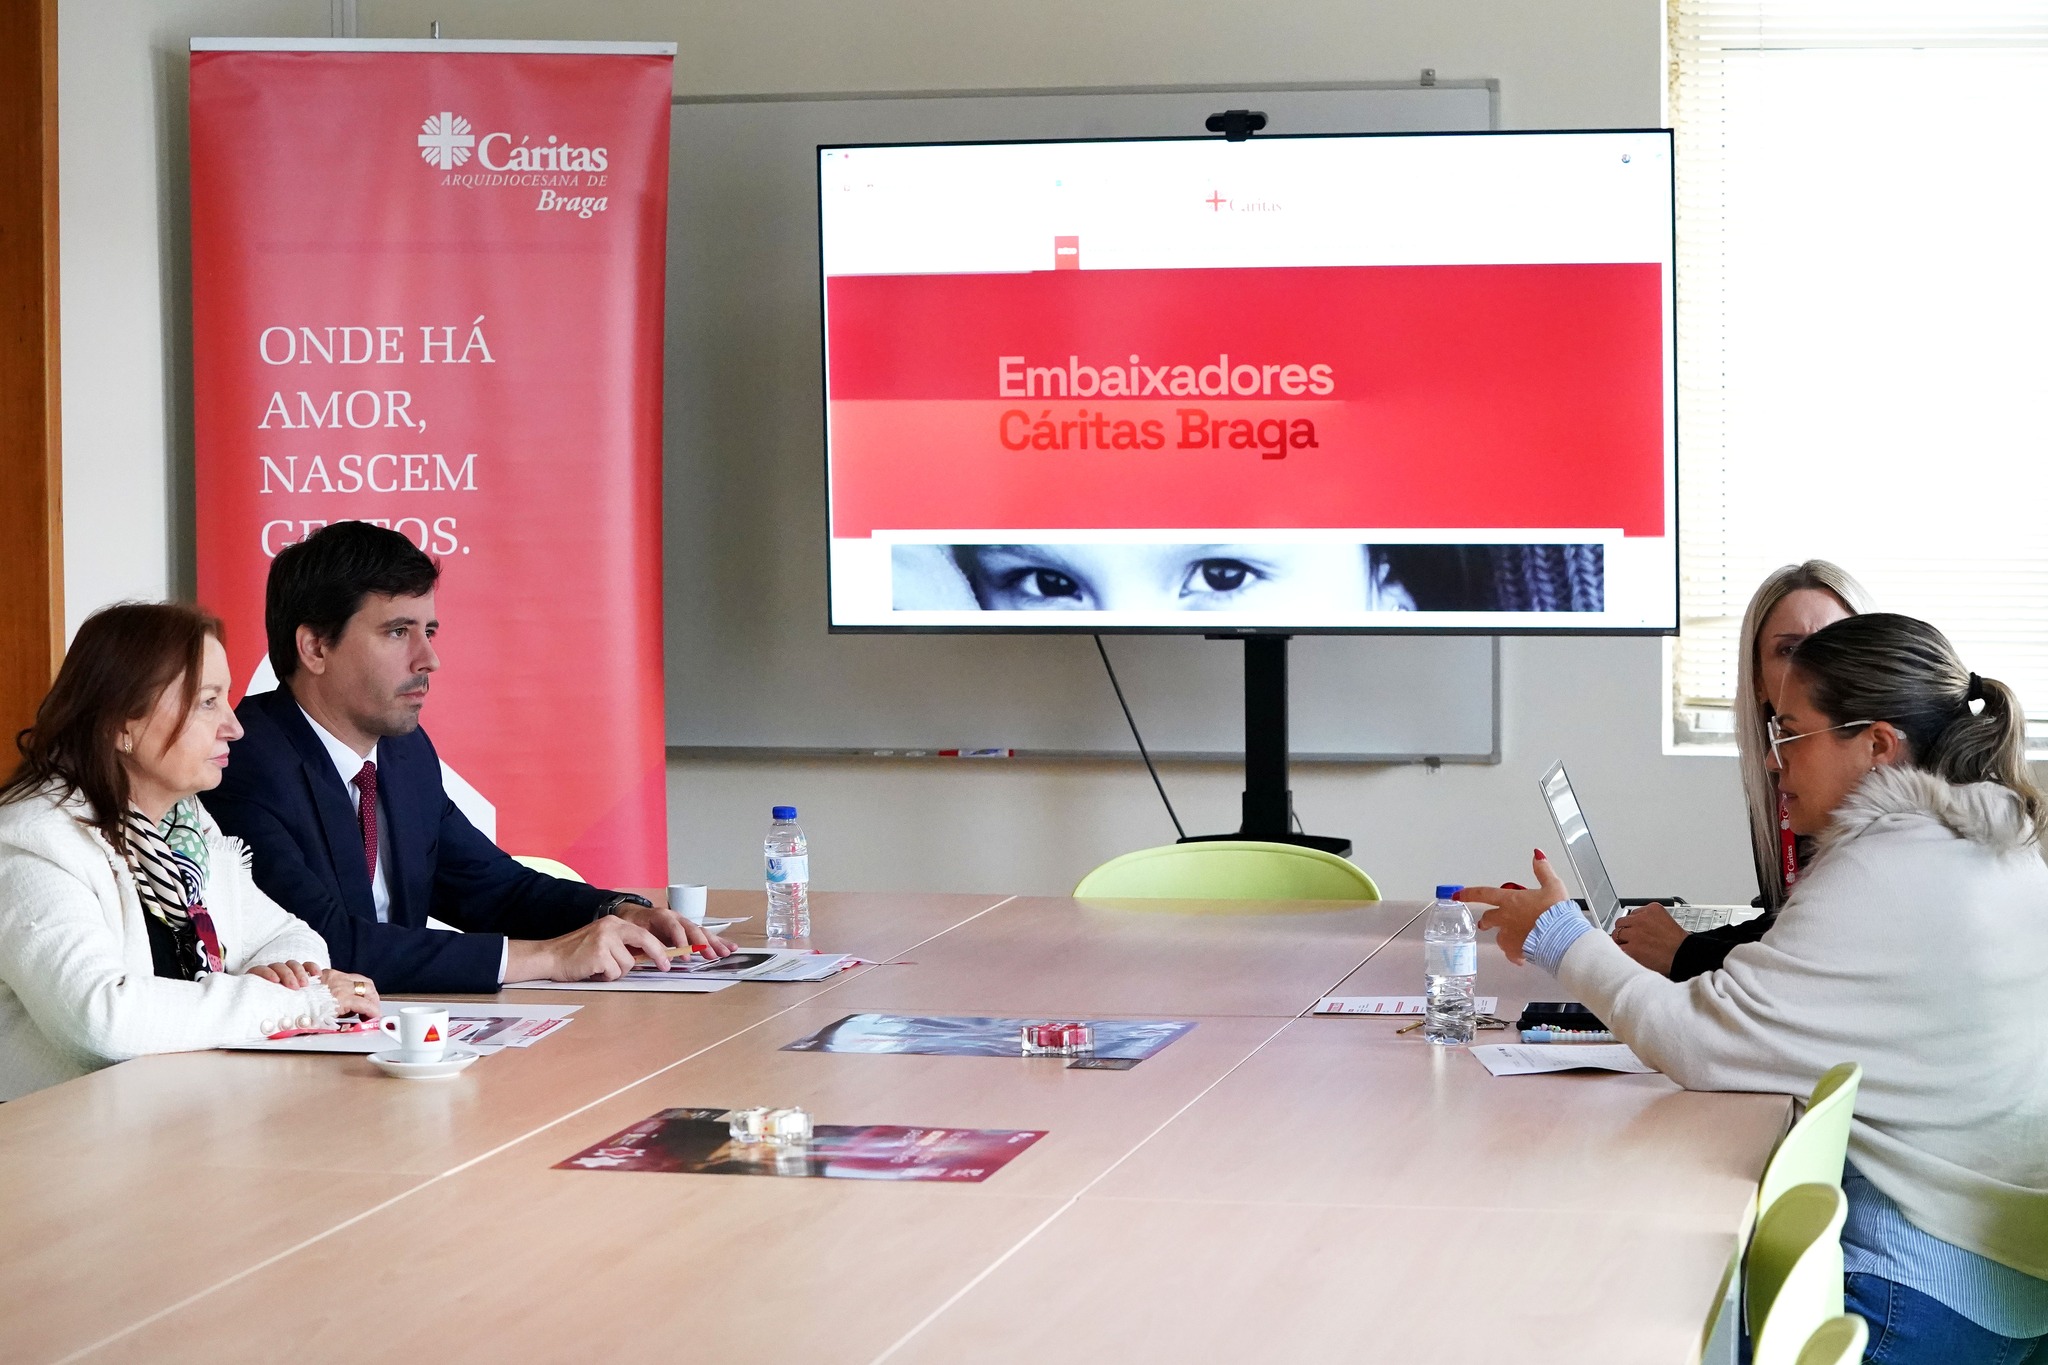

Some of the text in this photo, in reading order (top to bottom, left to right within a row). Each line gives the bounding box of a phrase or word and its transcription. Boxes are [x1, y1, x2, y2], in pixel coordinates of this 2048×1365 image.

[478, 133, 608, 172] Cáritas
[441, 174, 608, 189] ARQUIDIOCESANA DE
[536, 189, 608, 219] Braga
[259, 315, 496, 365] ONDE HÁ
[999, 354, 1335, 398] Embaixadores
[258, 389, 427, 434] AMOR,
[1000, 408, 1319, 460] Cáritas Braga
[259, 453, 478, 494] NASCEM
